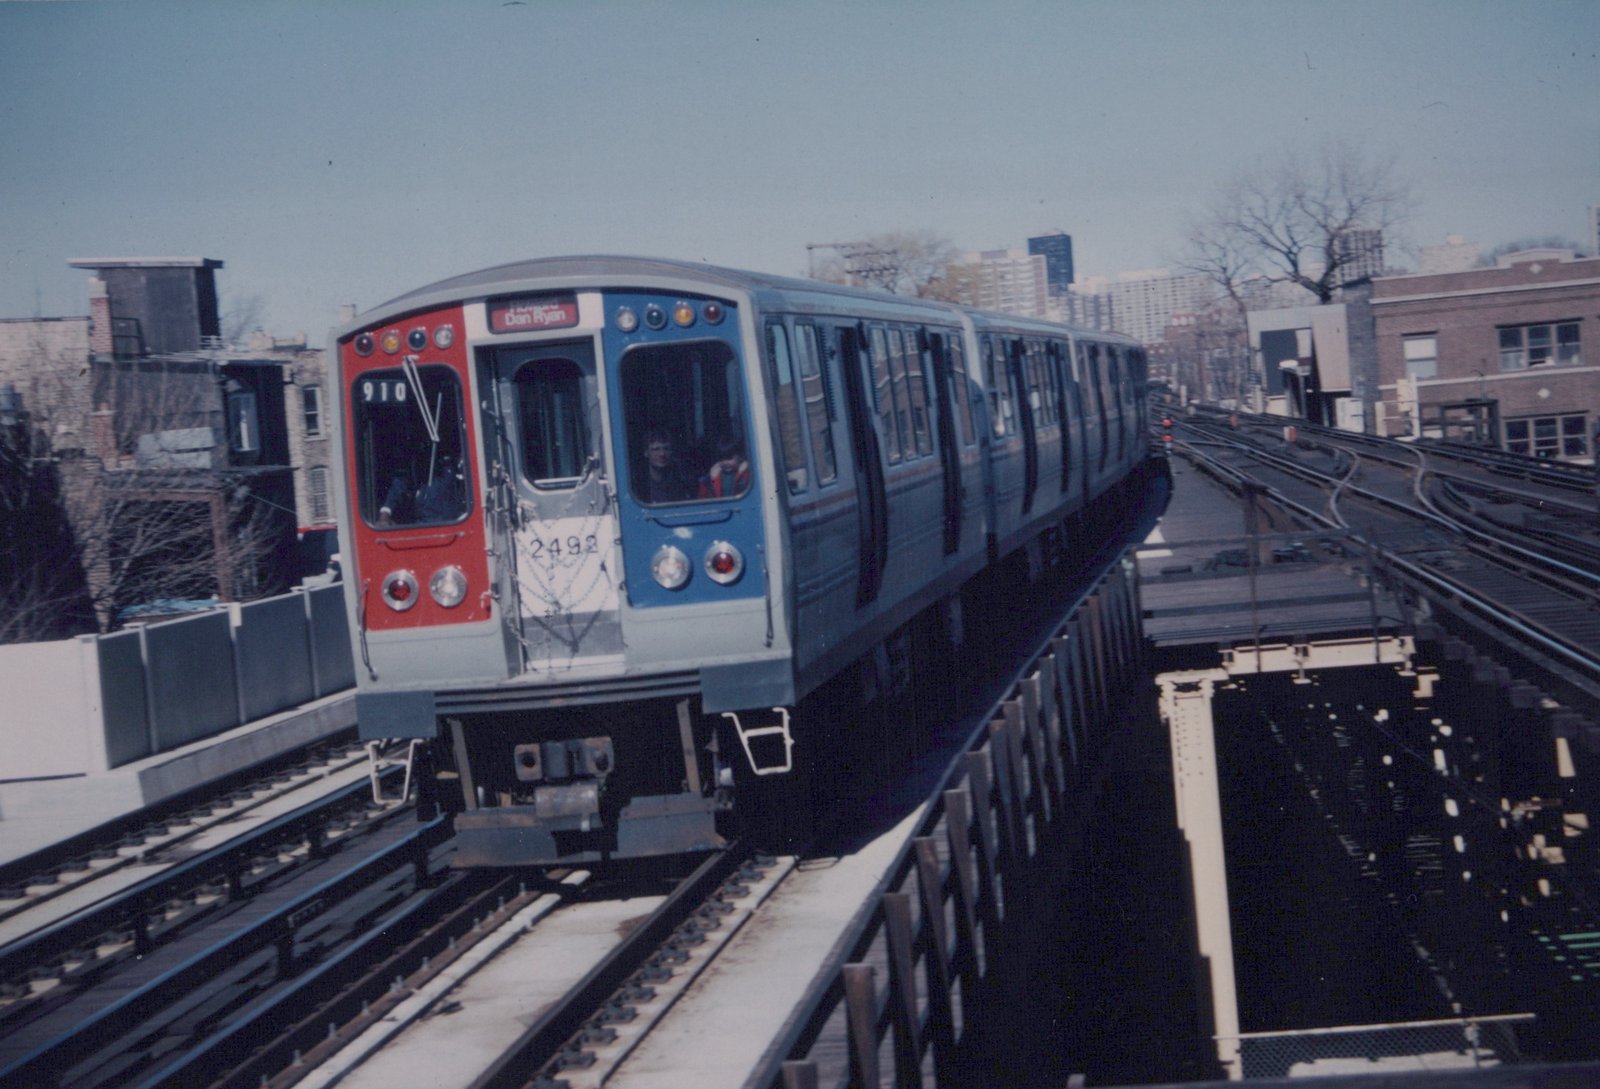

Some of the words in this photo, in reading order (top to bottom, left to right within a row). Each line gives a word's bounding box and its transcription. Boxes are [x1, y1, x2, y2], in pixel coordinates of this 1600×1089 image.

[504, 312, 532, 326] Dan
[533, 309, 566, 326] Ryan
[363, 382, 406, 402] 910
